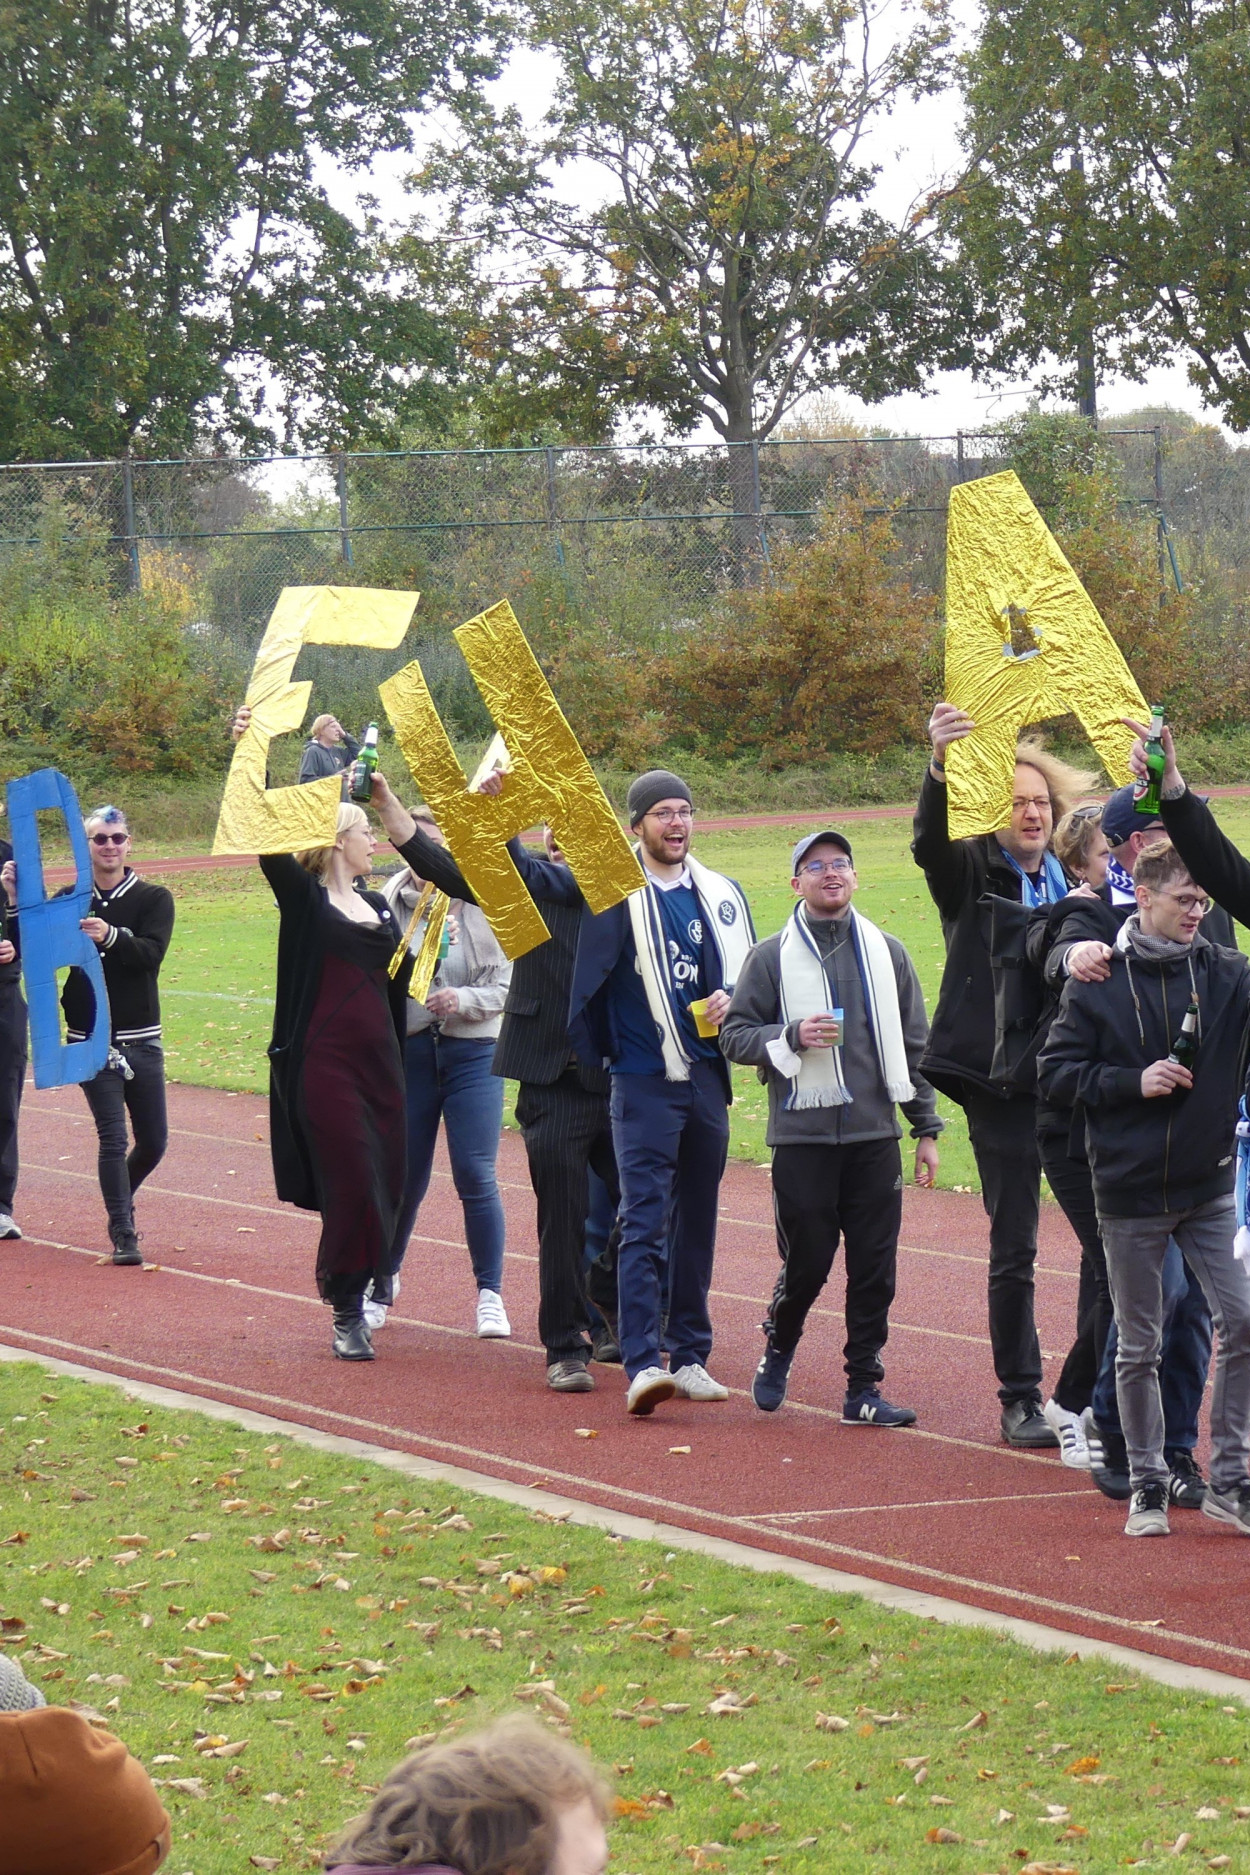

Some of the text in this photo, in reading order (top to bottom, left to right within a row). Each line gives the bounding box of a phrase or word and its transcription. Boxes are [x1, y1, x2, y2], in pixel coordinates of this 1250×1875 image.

[211, 585, 421, 856] E
[379, 599, 648, 961] H
[946, 470, 1152, 840] A
